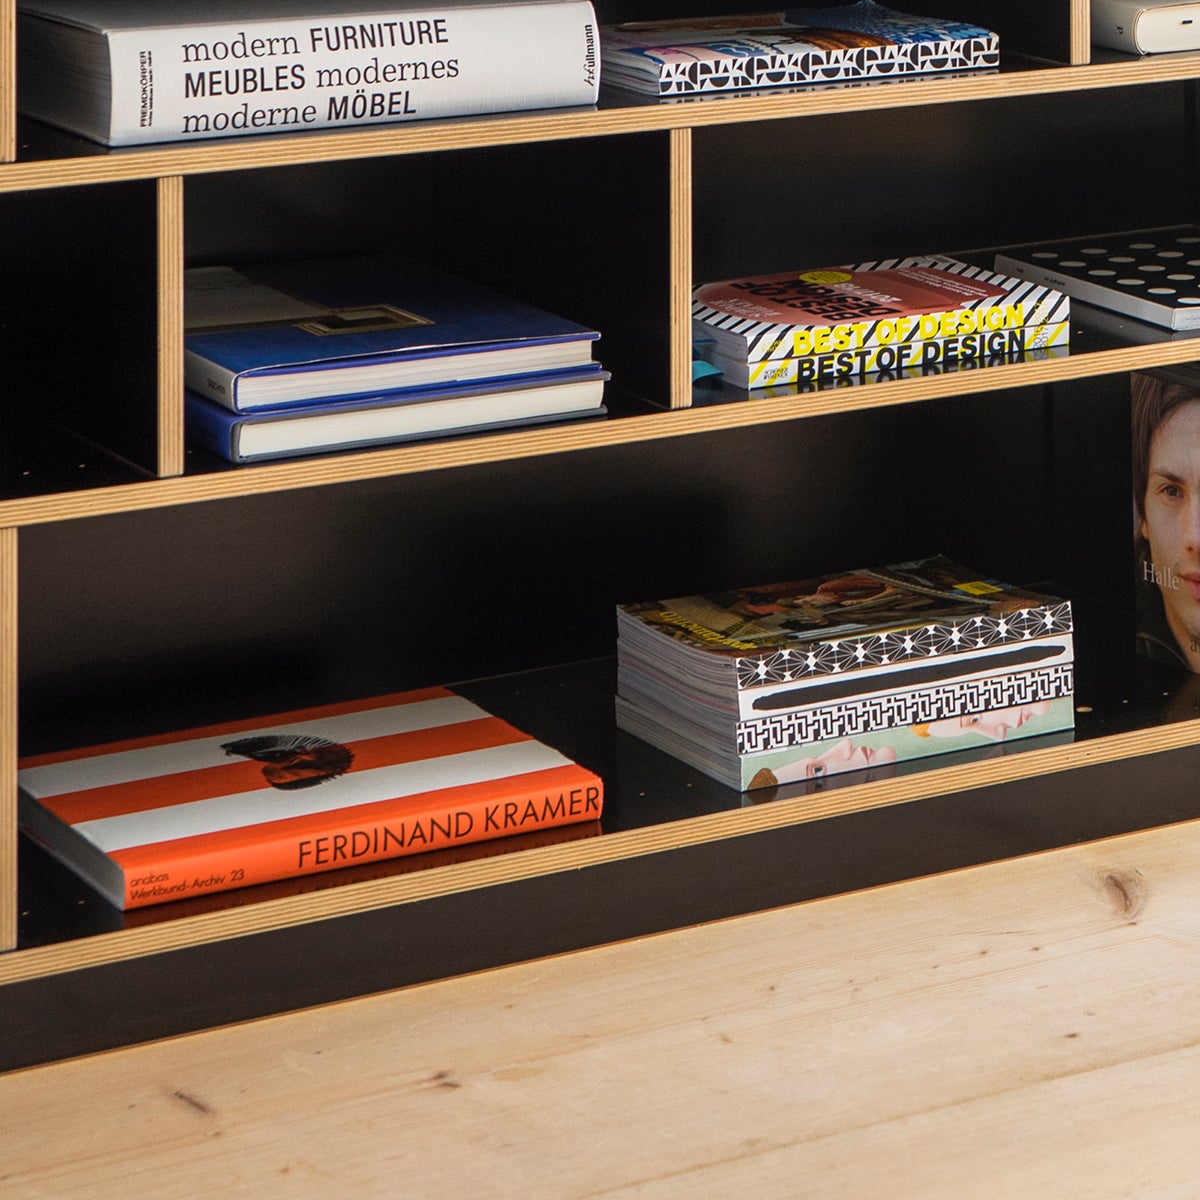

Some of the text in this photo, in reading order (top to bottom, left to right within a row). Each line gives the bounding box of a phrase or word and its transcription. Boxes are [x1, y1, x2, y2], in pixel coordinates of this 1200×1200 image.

[181, 18, 450, 63] modern FURNITURE
[139, 50, 148, 128] FREMDKÖRPER
[184, 55, 459, 99] MEUBLES modernes
[181, 90, 417, 133] moderne MÖBEL
[793, 323, 870, 357] BEST
[874, 317, 914, 347] OF
[919, 303, 1025, 338] DESIGN
[797, 345, 871, 382] BEST
[876, 342, 914, 372] OF
[921, 329, 1026, 364] DESIGN
[1142, 560, 1180, 590] Halle
[298, 785, 600, 868] FERDINAND KRAMER
[130, 871, 170, 887] anabas
[231, 869, 245, 883] 23
